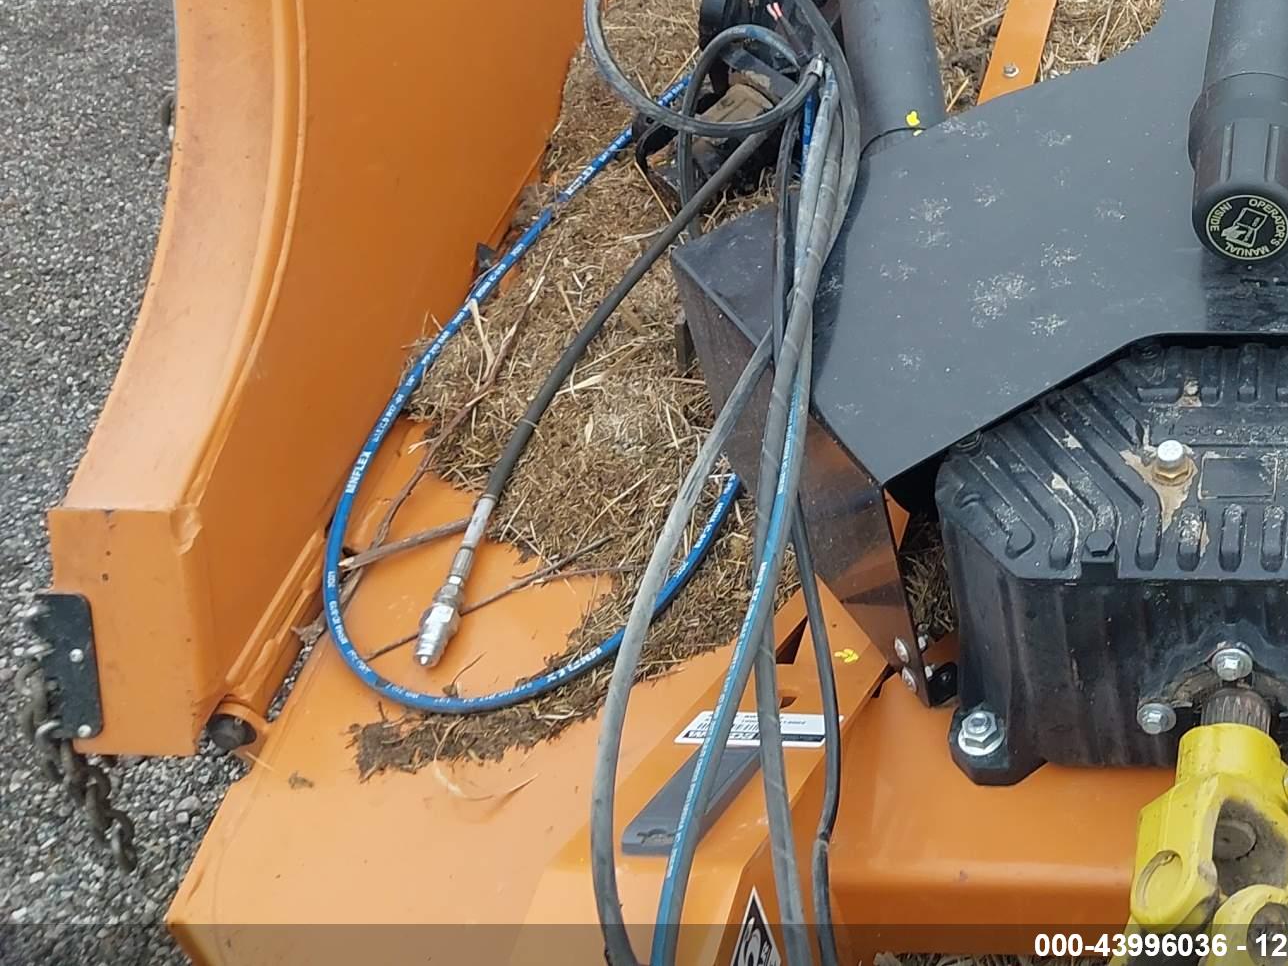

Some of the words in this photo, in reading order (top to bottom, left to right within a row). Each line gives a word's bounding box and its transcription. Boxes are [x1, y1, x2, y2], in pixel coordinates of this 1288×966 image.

[1209, 201, 1233, 232] INSIDE
[1248, 198, 1286, 246] OPERATOR'S
[1224, 241, 1270, 257] MANUAL
